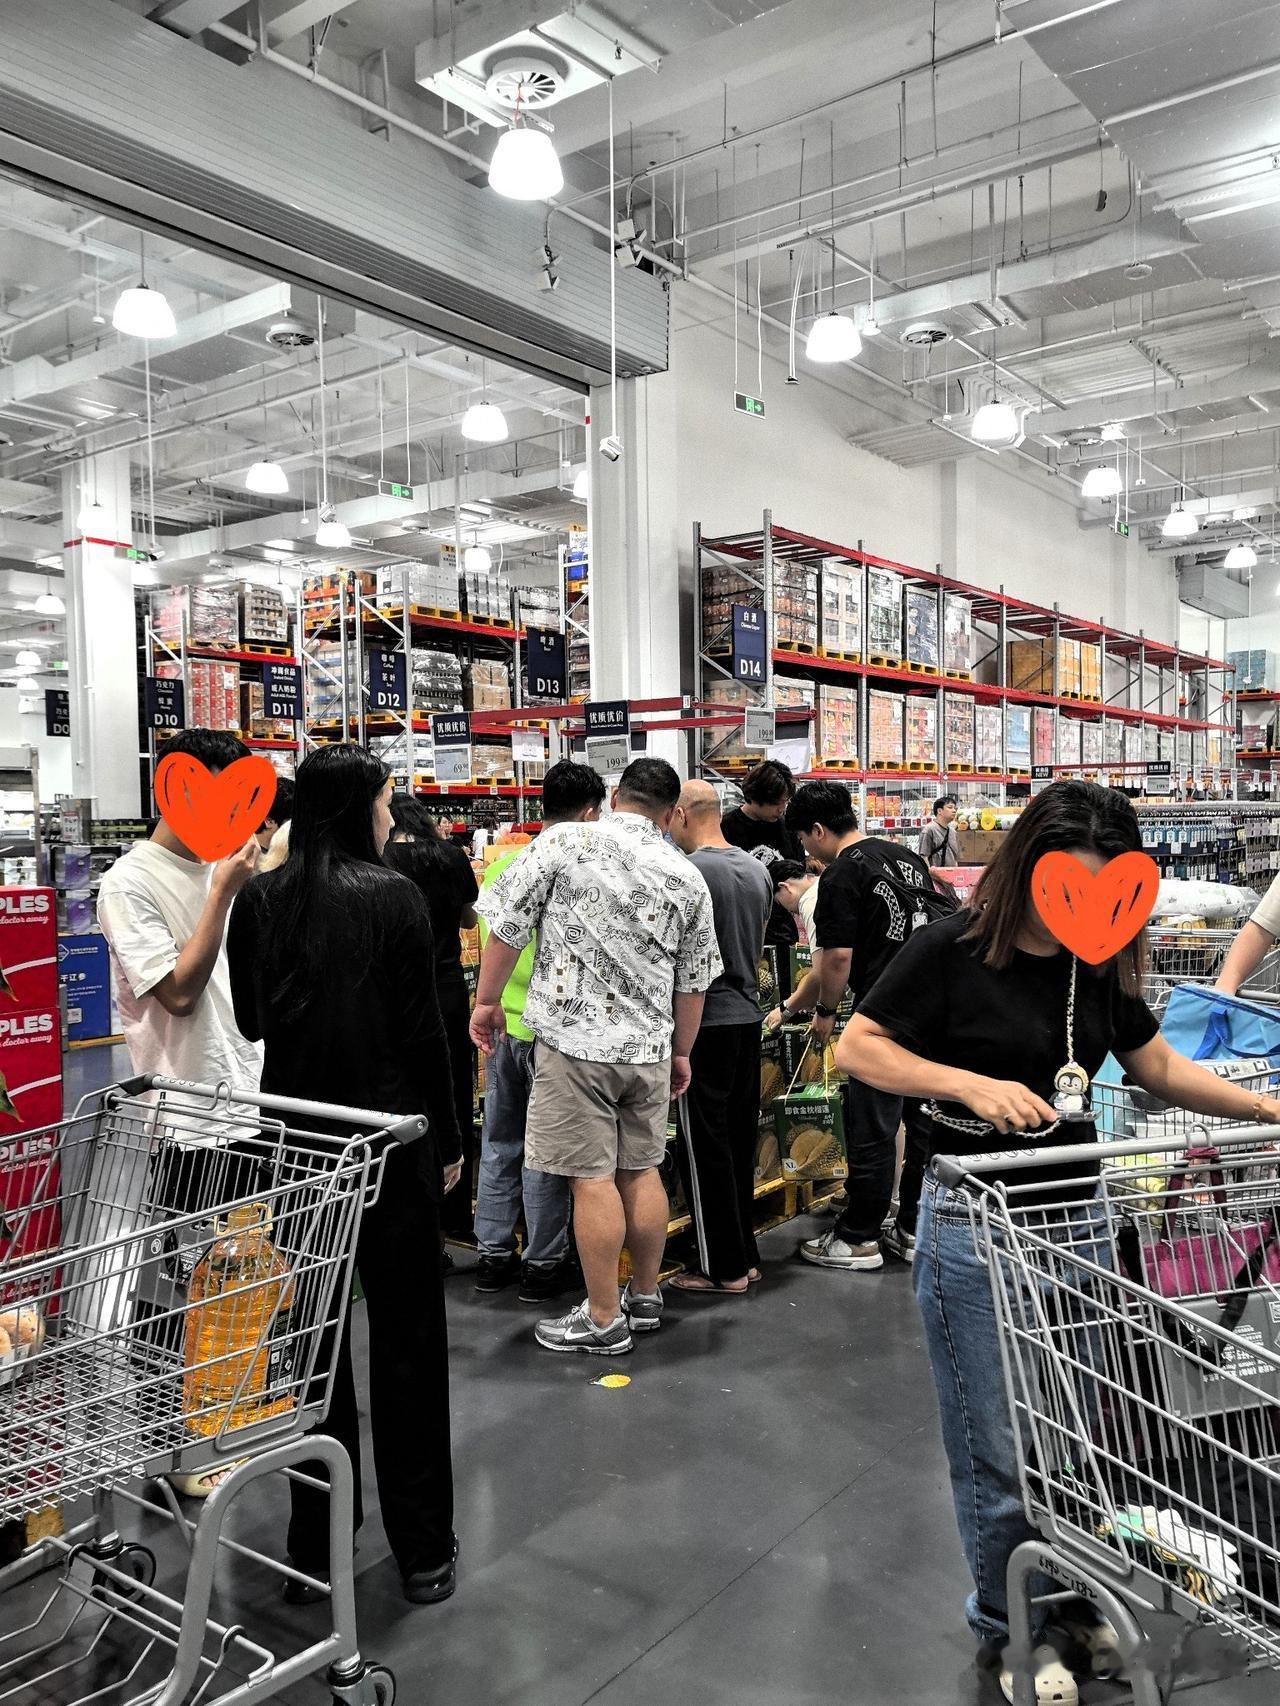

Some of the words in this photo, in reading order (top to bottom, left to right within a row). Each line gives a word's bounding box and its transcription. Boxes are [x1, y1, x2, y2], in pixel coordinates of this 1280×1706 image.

[743, 611, 757, 623] 白酒
[540, 635, 555, 646] 啤酒
[381, 654, 395, 663] 咖啡
[740, 658, 761, 677] D14
[155, 680, 175, 689] 巧克力
[536, 677, 560, 694] D13
[377, 691, 401, 707] D12
[272, 702, 294, 716] D11
[154, 713, 178, 726] D10
[589, 710, 624, 723] 优质优价
[53, 723, 69, 734] D0
[437, 721, 467, 734] 优质优价
[26, 916, 49, 924] away
[3, 1037, 29, 1047] doctor
[30, 1034, 52, 1043] away
[784, 1105, 830, 1115] 即食金枕榴莲
